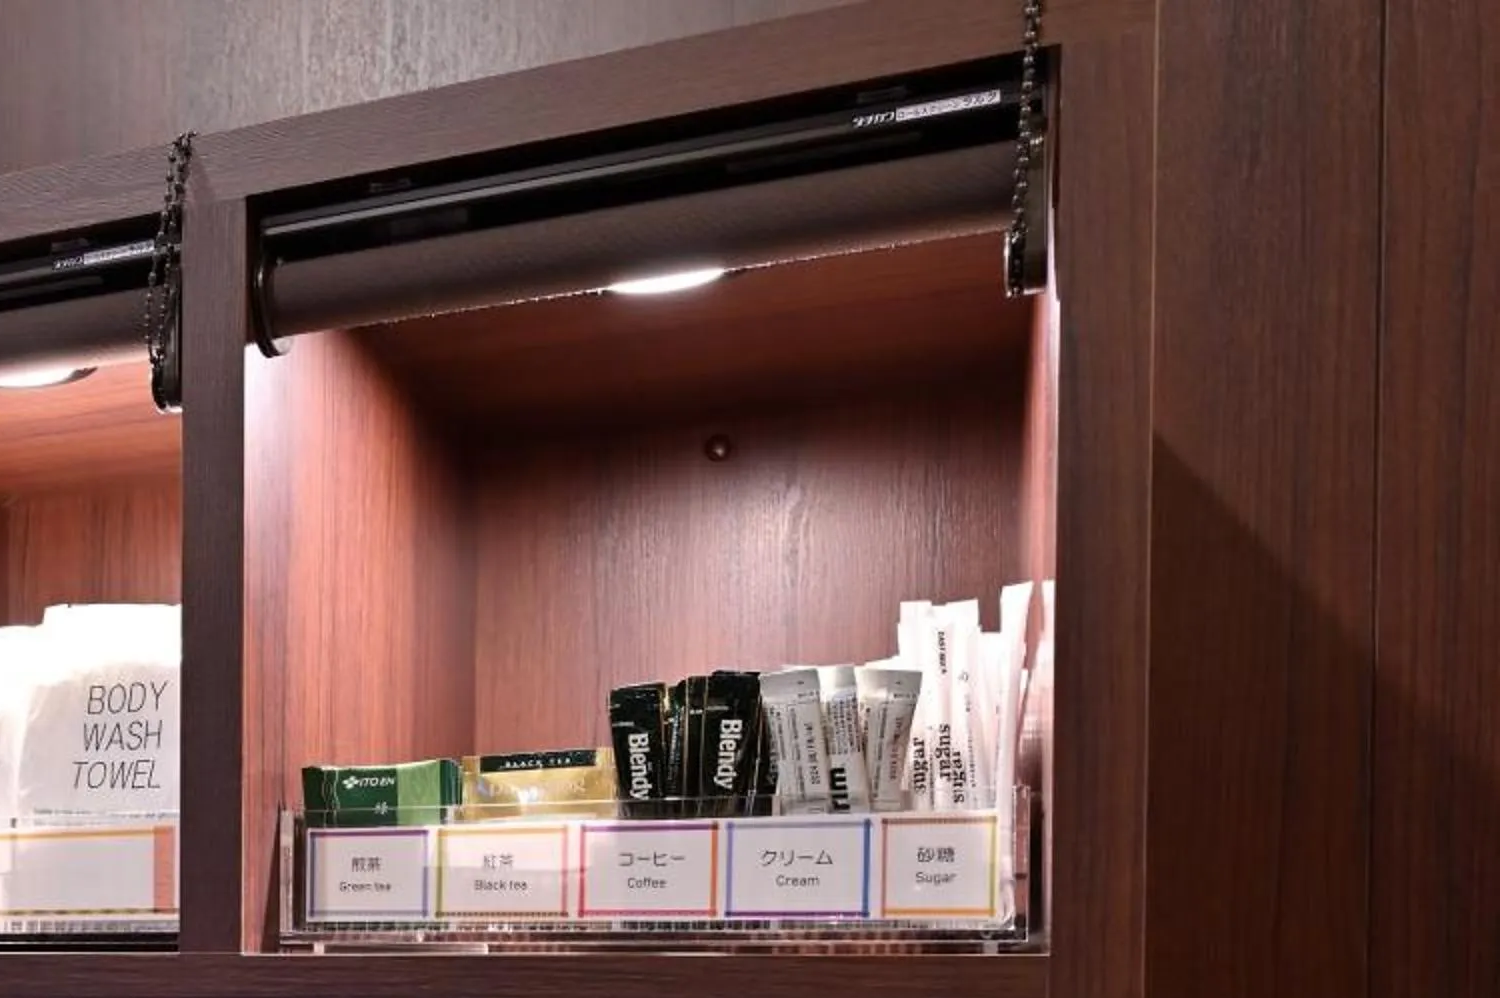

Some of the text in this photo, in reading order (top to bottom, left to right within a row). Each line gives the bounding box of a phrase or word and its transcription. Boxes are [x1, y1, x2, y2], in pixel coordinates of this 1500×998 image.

[87, 680, 168, 715] BODY
[83, 719, 163, 751] WASH
[714, 719, 743, 789] Blendy
[72, 759, 161, 790] TOWEL
[628, 733, 652, 800] Blendy
[618, 852, 686, 867] コーヒー
[761, 850, 833, 867] クリーム
[916, 847, 955, 862] 砂糖
[474, 879, 528, 891] Black tea
[627, 877, 667, 888] Coffee
[776, 875, 820, 887] Cream
[915, 871, 957, 886] Sugar
